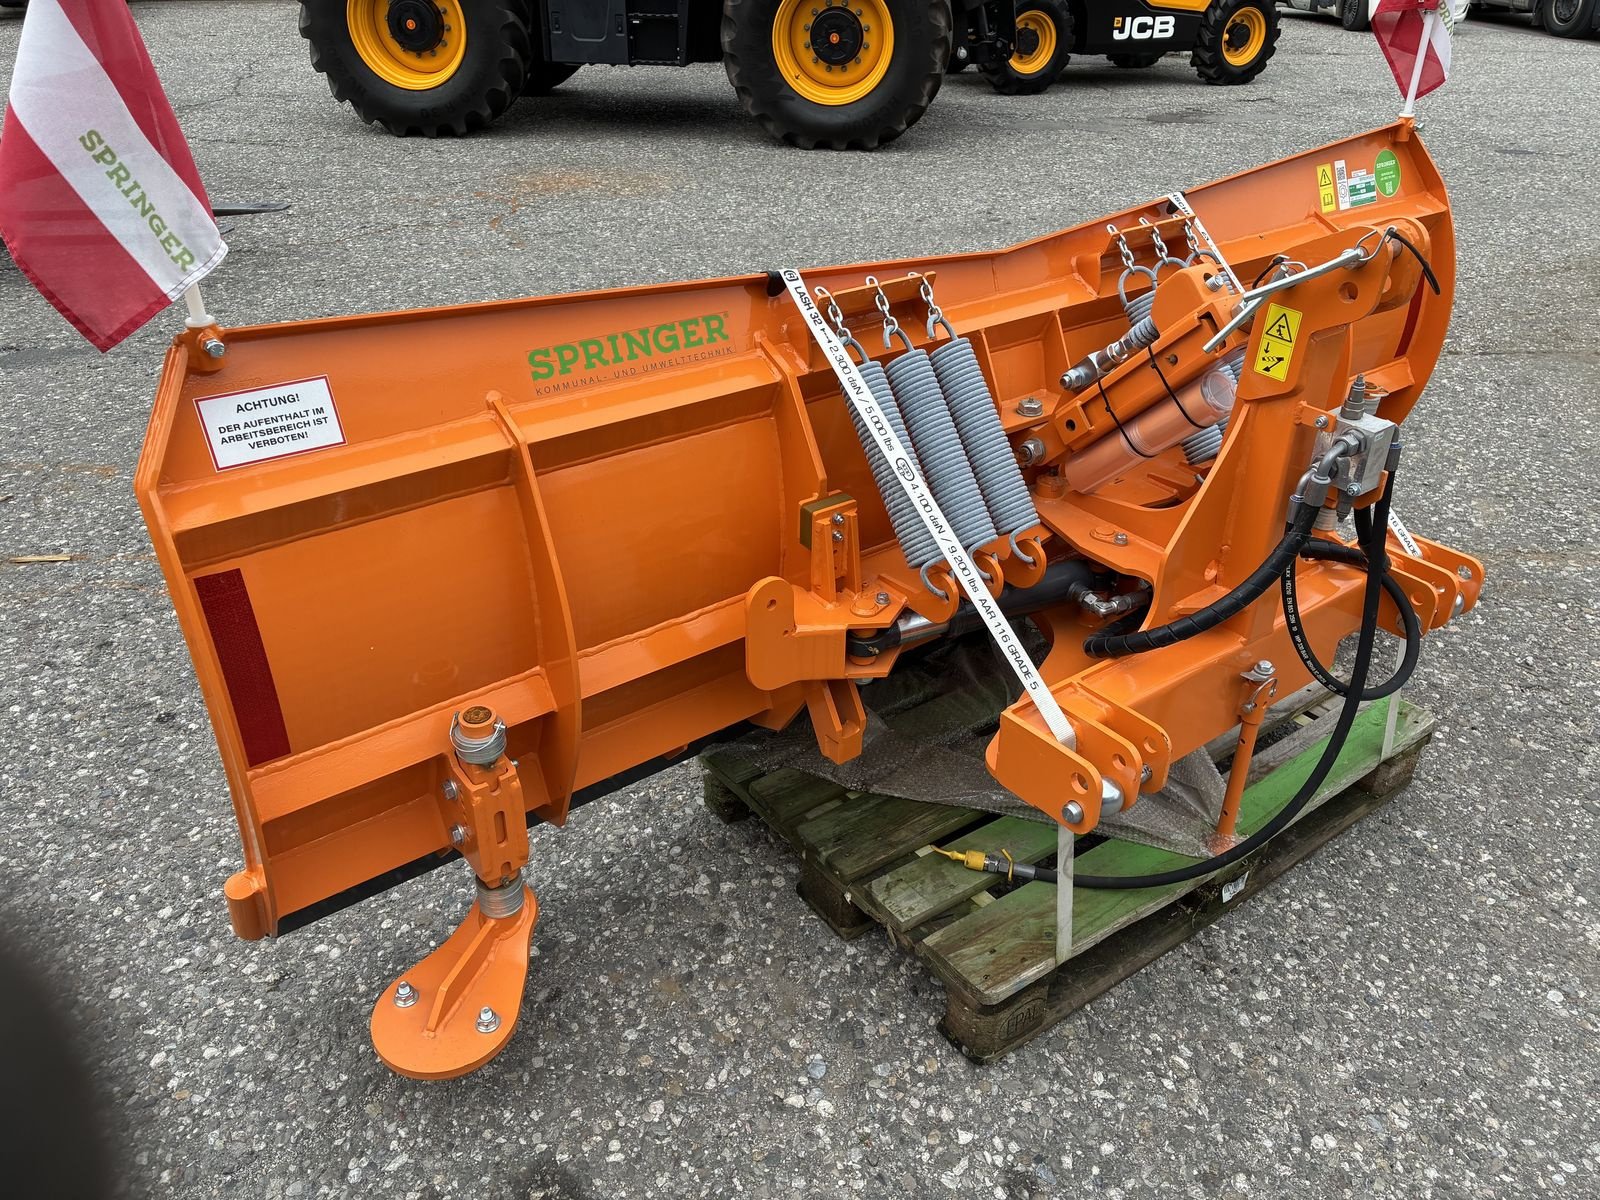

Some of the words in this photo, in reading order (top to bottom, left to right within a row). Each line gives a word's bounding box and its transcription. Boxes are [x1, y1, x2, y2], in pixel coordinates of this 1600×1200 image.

[1112, 15, 1175, 40] JCB
[78, 129, 196, 273] SPRINGER
[527, 314, 730, 382] SPRINGER
[535, 375, 608, 396] KOMMUNAL-
[613, 367, 637, 380] UND
[642, 346, 733, 373] UMWELTTECHNIK
[794, 285, 814, 311] LASH
[809, 312, 823, 327] 32
[829, 345, 852, 376] 2.300
[847, 376, 865, 396] daN
[865, 405, 888, 438] 5.000
[882, 437, 895, 452] lbs
[235, 393, 300, 414] ACHTUNG!
[218, 423, 242, 435] DER
[243, 410, 310, 430] AUFENTHALT
[312, 406, 325, 416] IM
[220, 420, 311, 445] ARBEITSBEREICH
[313, 416, 329, 427] IST
[248, 431, 309, 450] VERBOTEN!
[1397, 527, 1418, 556] GRADE
[910, 482, 933, 514] 4.100
[928, 513, 946, 534] daN
[948, 545, 972, 578] 9.200
[966, 578, 980, 593] lbs
[978, 598, 997, 620] AAR
[994, 621, 1011, 643] 116
[1007, 643, 1034, 680] GRADE
[1029, 681, 1040, 691] 5
